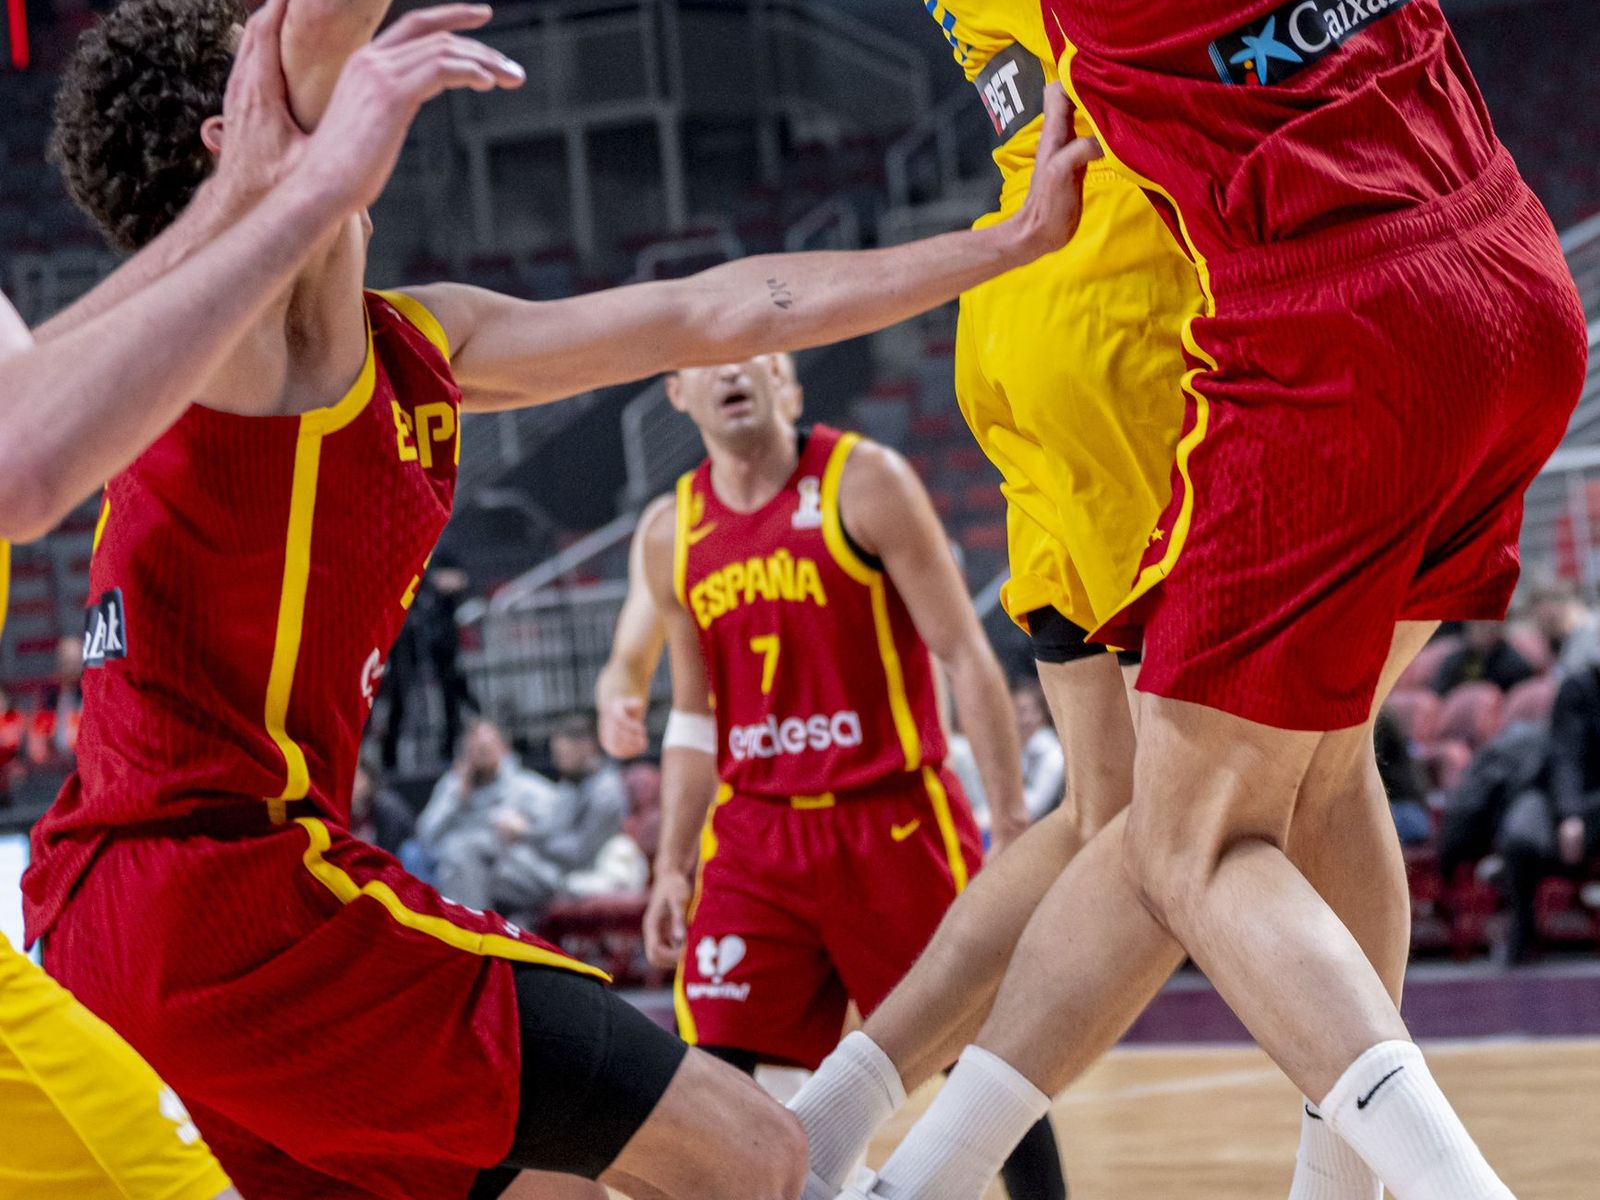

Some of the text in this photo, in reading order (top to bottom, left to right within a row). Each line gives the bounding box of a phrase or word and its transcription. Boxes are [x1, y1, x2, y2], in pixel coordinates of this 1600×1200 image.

[689, 548, 827, 629] ESPAÑA
[750, 634, 780, 695] 7
[728, 710, 863, 761] endesa
